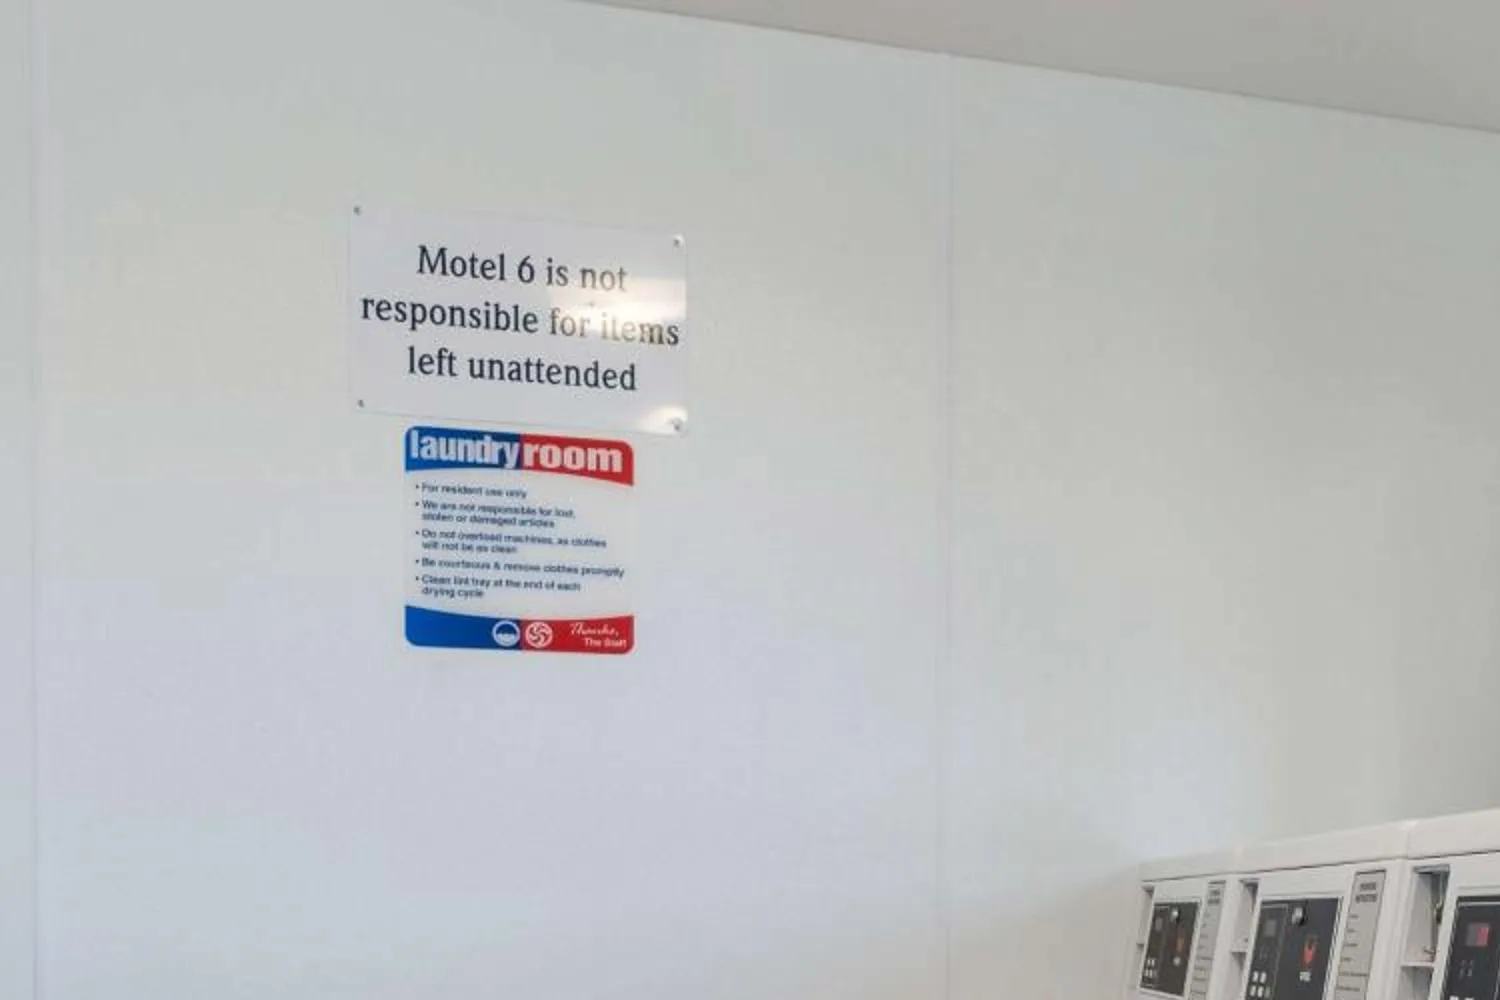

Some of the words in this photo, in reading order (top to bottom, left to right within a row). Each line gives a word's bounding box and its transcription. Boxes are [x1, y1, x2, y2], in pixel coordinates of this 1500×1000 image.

[416, 245, 505, 281] Motel
[517, 255, 535, 283] 6
[546, 258, 568, 287] is
[581, 265, 628, 293] not
[362, 297, 539, 334] responsible
[550, 308, 589, 337] for
[601, 313, 679, 346] items
[407, 346, 457, 376] left
[469, 358, 637, 390] unattended
[409, 430, 520, 468] laundry
[523, 442, 622, 473] room
[422, 482, 439, 492] For
[441, 484, 482, 495] resident
[485, 488, 503, 496] use
[505, 488, 527, 500] only
[422, 500, 438, 509] We
[459, 503, 475, 511] not
[478, 503, 536, 518] responsible
[539, 507, 552, 516] for
[422, 511, 453, 521] stolen
[456, 514, 467, 522] or
[469, 514, 515, 527] damaged
[518, 517, 554, 527] articles
[422, 529, 436, 538] Do
[439, 530, 455, 539] not
[458, 531, 502, 542] overload
[571, 537, 605, 547] clothes
[422, 540, 439, 549] will
[441, 542, 459, 550] not
[462, 543, 473, 551] be
[491, 544, 516, 553] clean
[422, 557, 435, 566] Be
[438, 558, 490, 569] courteous
[503, 563, 539, 572] remove
[543, 564, 577, 574] clothes
[581, 566, 624, 579] promptly
[422, 574, 450, 584] Clean
[453, 576, 469, 585] lint
[471, 577, 489, 588] tray
[493, 578, 502, 586] at
[505, 579, 520, 588] the
[523, 580, 542, 589] end
[544, 580, 554, 589] of
[557, 582, 580, 591] each
[422, 585, 454, 597] drying
[457, 588, 483, 598] cycle
